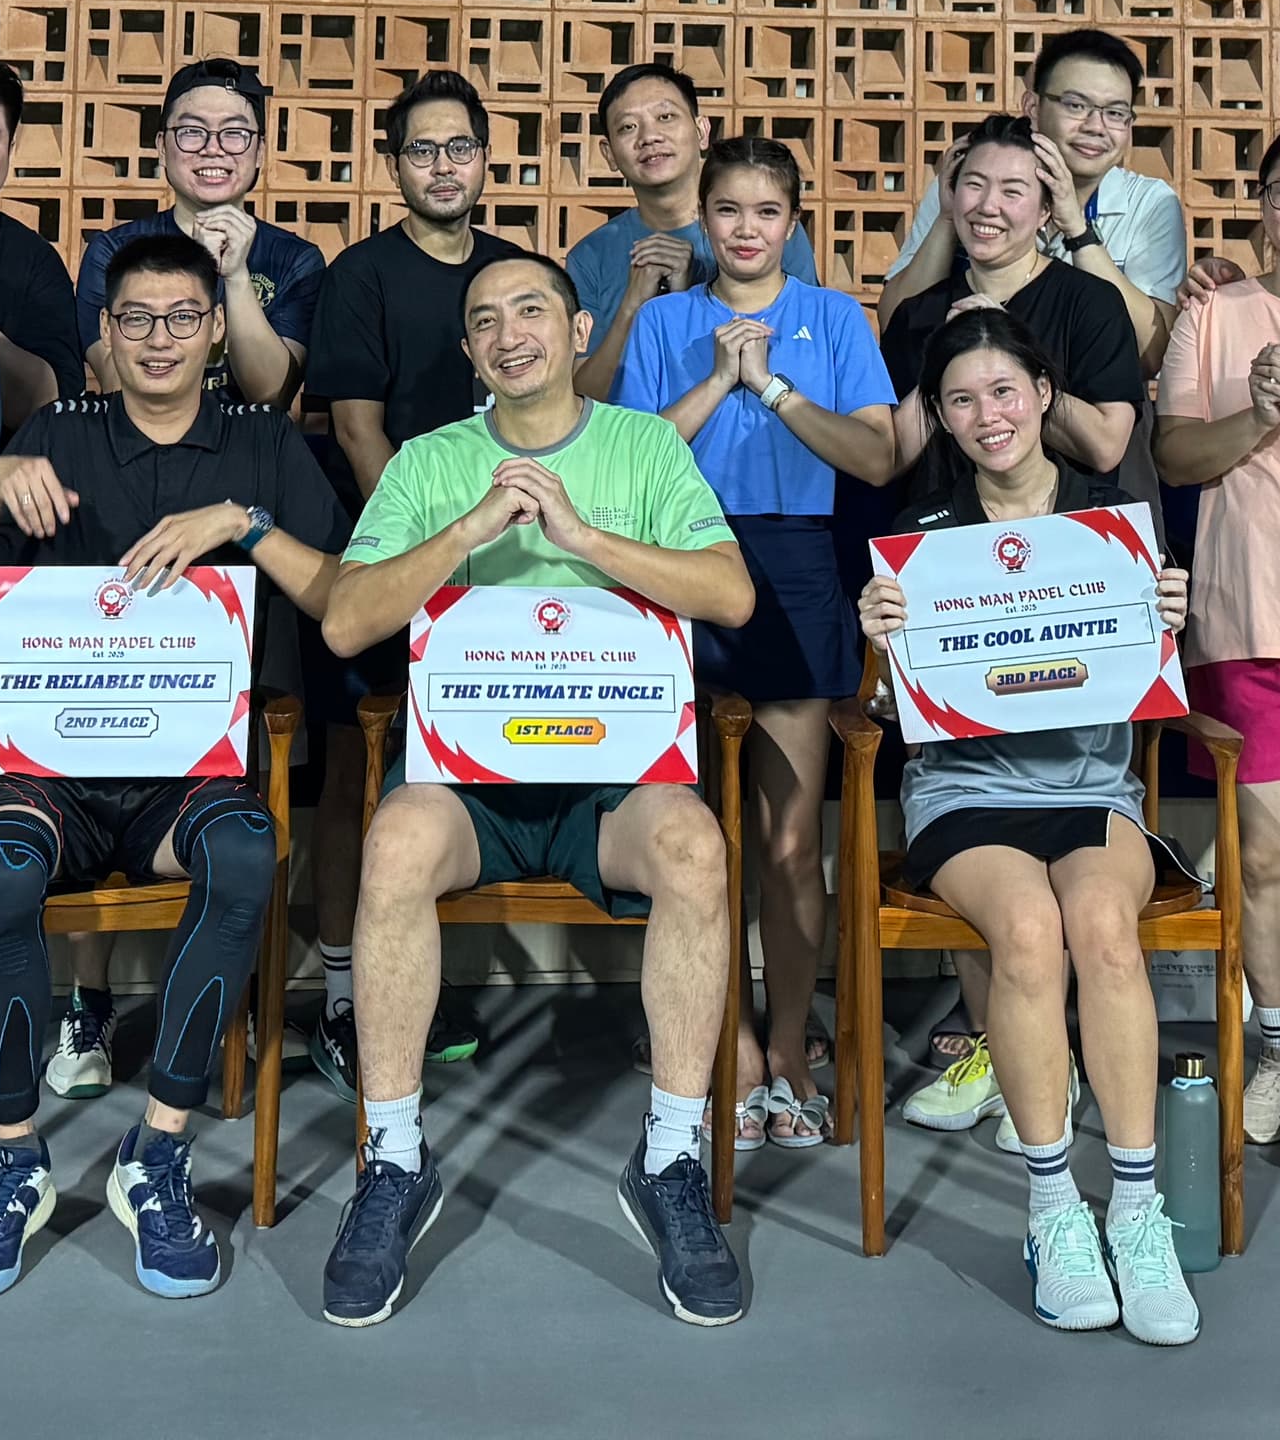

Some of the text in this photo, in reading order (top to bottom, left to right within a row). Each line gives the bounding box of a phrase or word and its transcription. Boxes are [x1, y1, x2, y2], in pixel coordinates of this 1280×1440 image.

[934, 581, 1106, 612] HONG MAN PADEL CLUB
[22, 636, 196, 650] HONG MAN PADEL CLUB
[939, 618, 1118, 652] THE COOL AUNTIE
[464, 651, 637, 662] HONG MAN PADEL CLUB
[0, 674, 217, 690] THE RELIABLE UNCLE
[996, 666, 1077, 686] 3RD PLACE
[441, 684, 665, 700] THE ULTIMATE UNCLE
[64, 717, 150, 728] 2ND PLACE
[516, 725, 594, 736] 1ST PLACE
